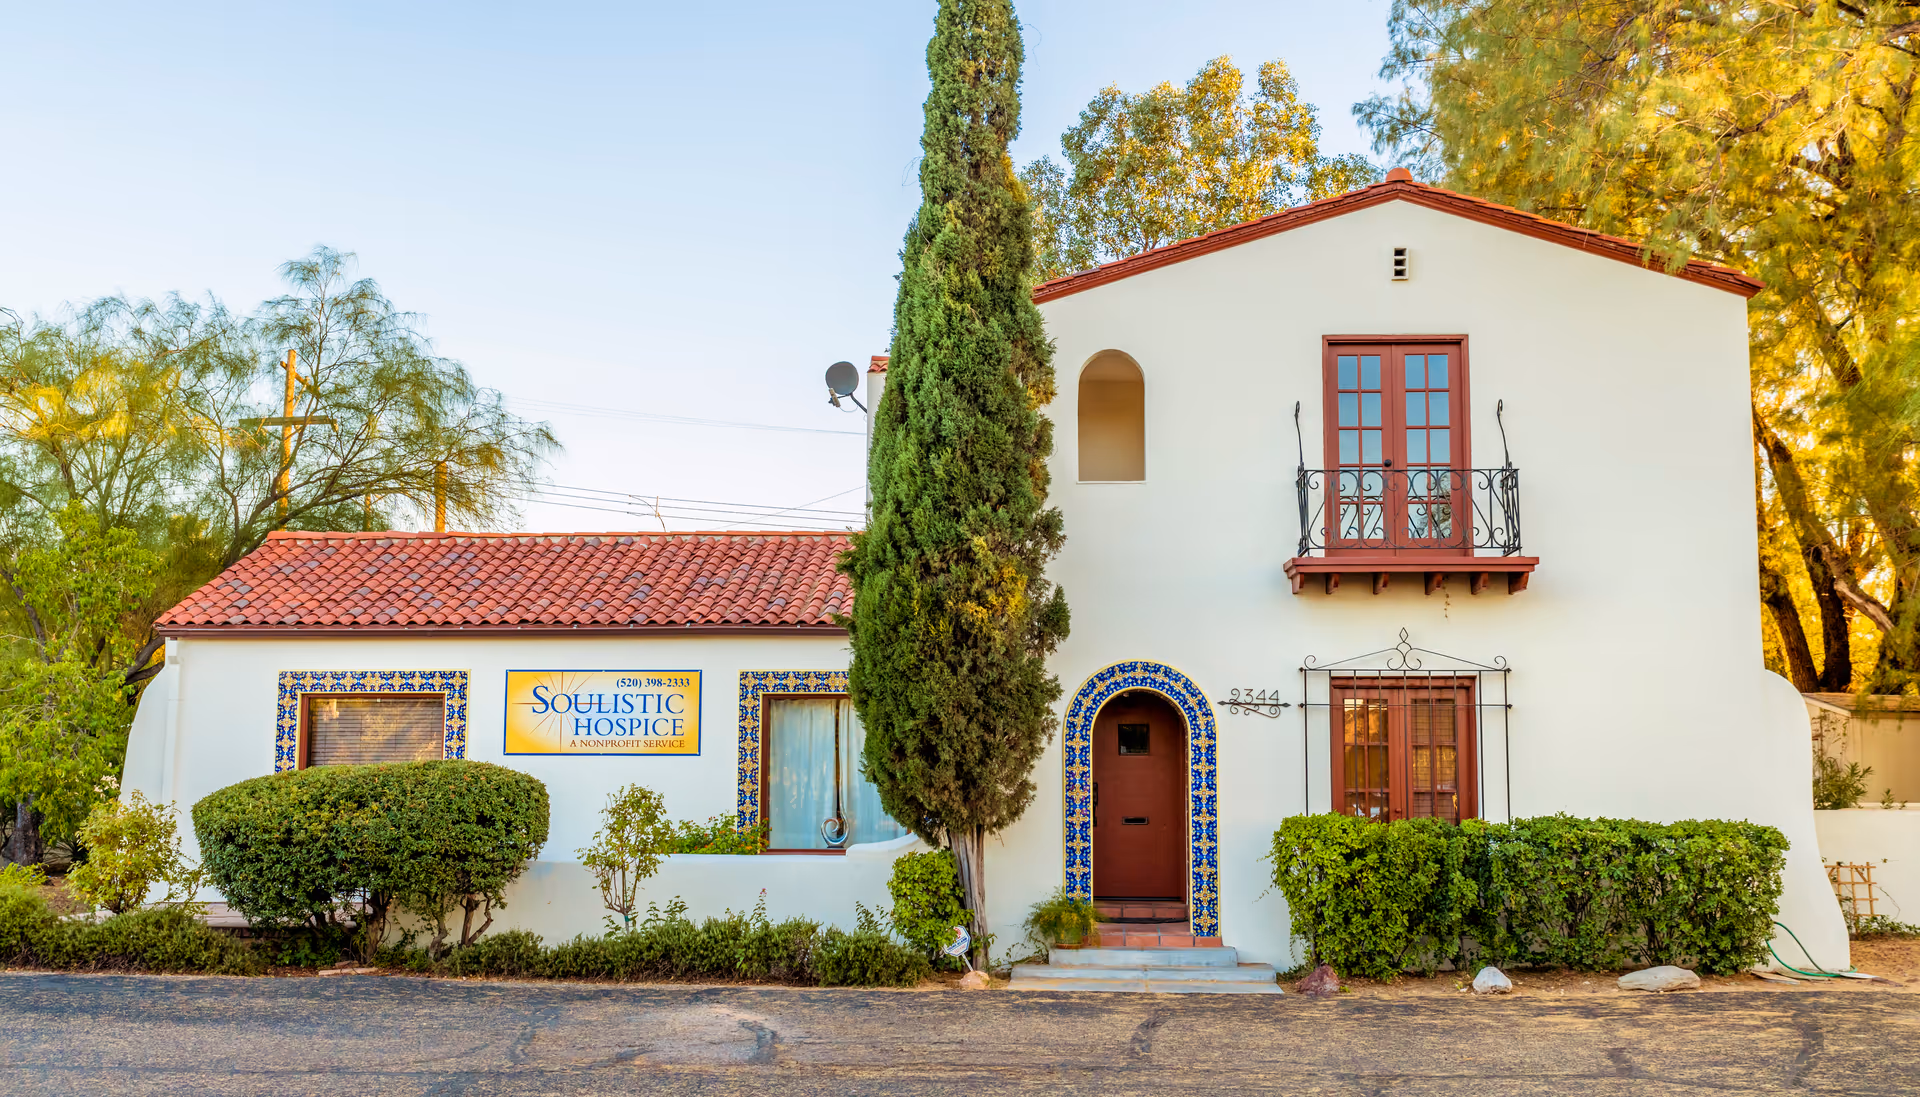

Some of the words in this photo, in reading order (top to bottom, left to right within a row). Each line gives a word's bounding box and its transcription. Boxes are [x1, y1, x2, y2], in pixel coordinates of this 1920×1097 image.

[616, 678, 642, 688] (520)
[644, 678, 690, 688] 398-2333
[532, 685, 685, 714] SOULISTIC
[1229, 688, 1279, 705] 2344
[573, 718, 685, 736] HOSPICE
[569, 739, 577, 748] A
[580, 739, 641, 748] NONPROFIT
[643, 739, 685, 748] SERVICE
